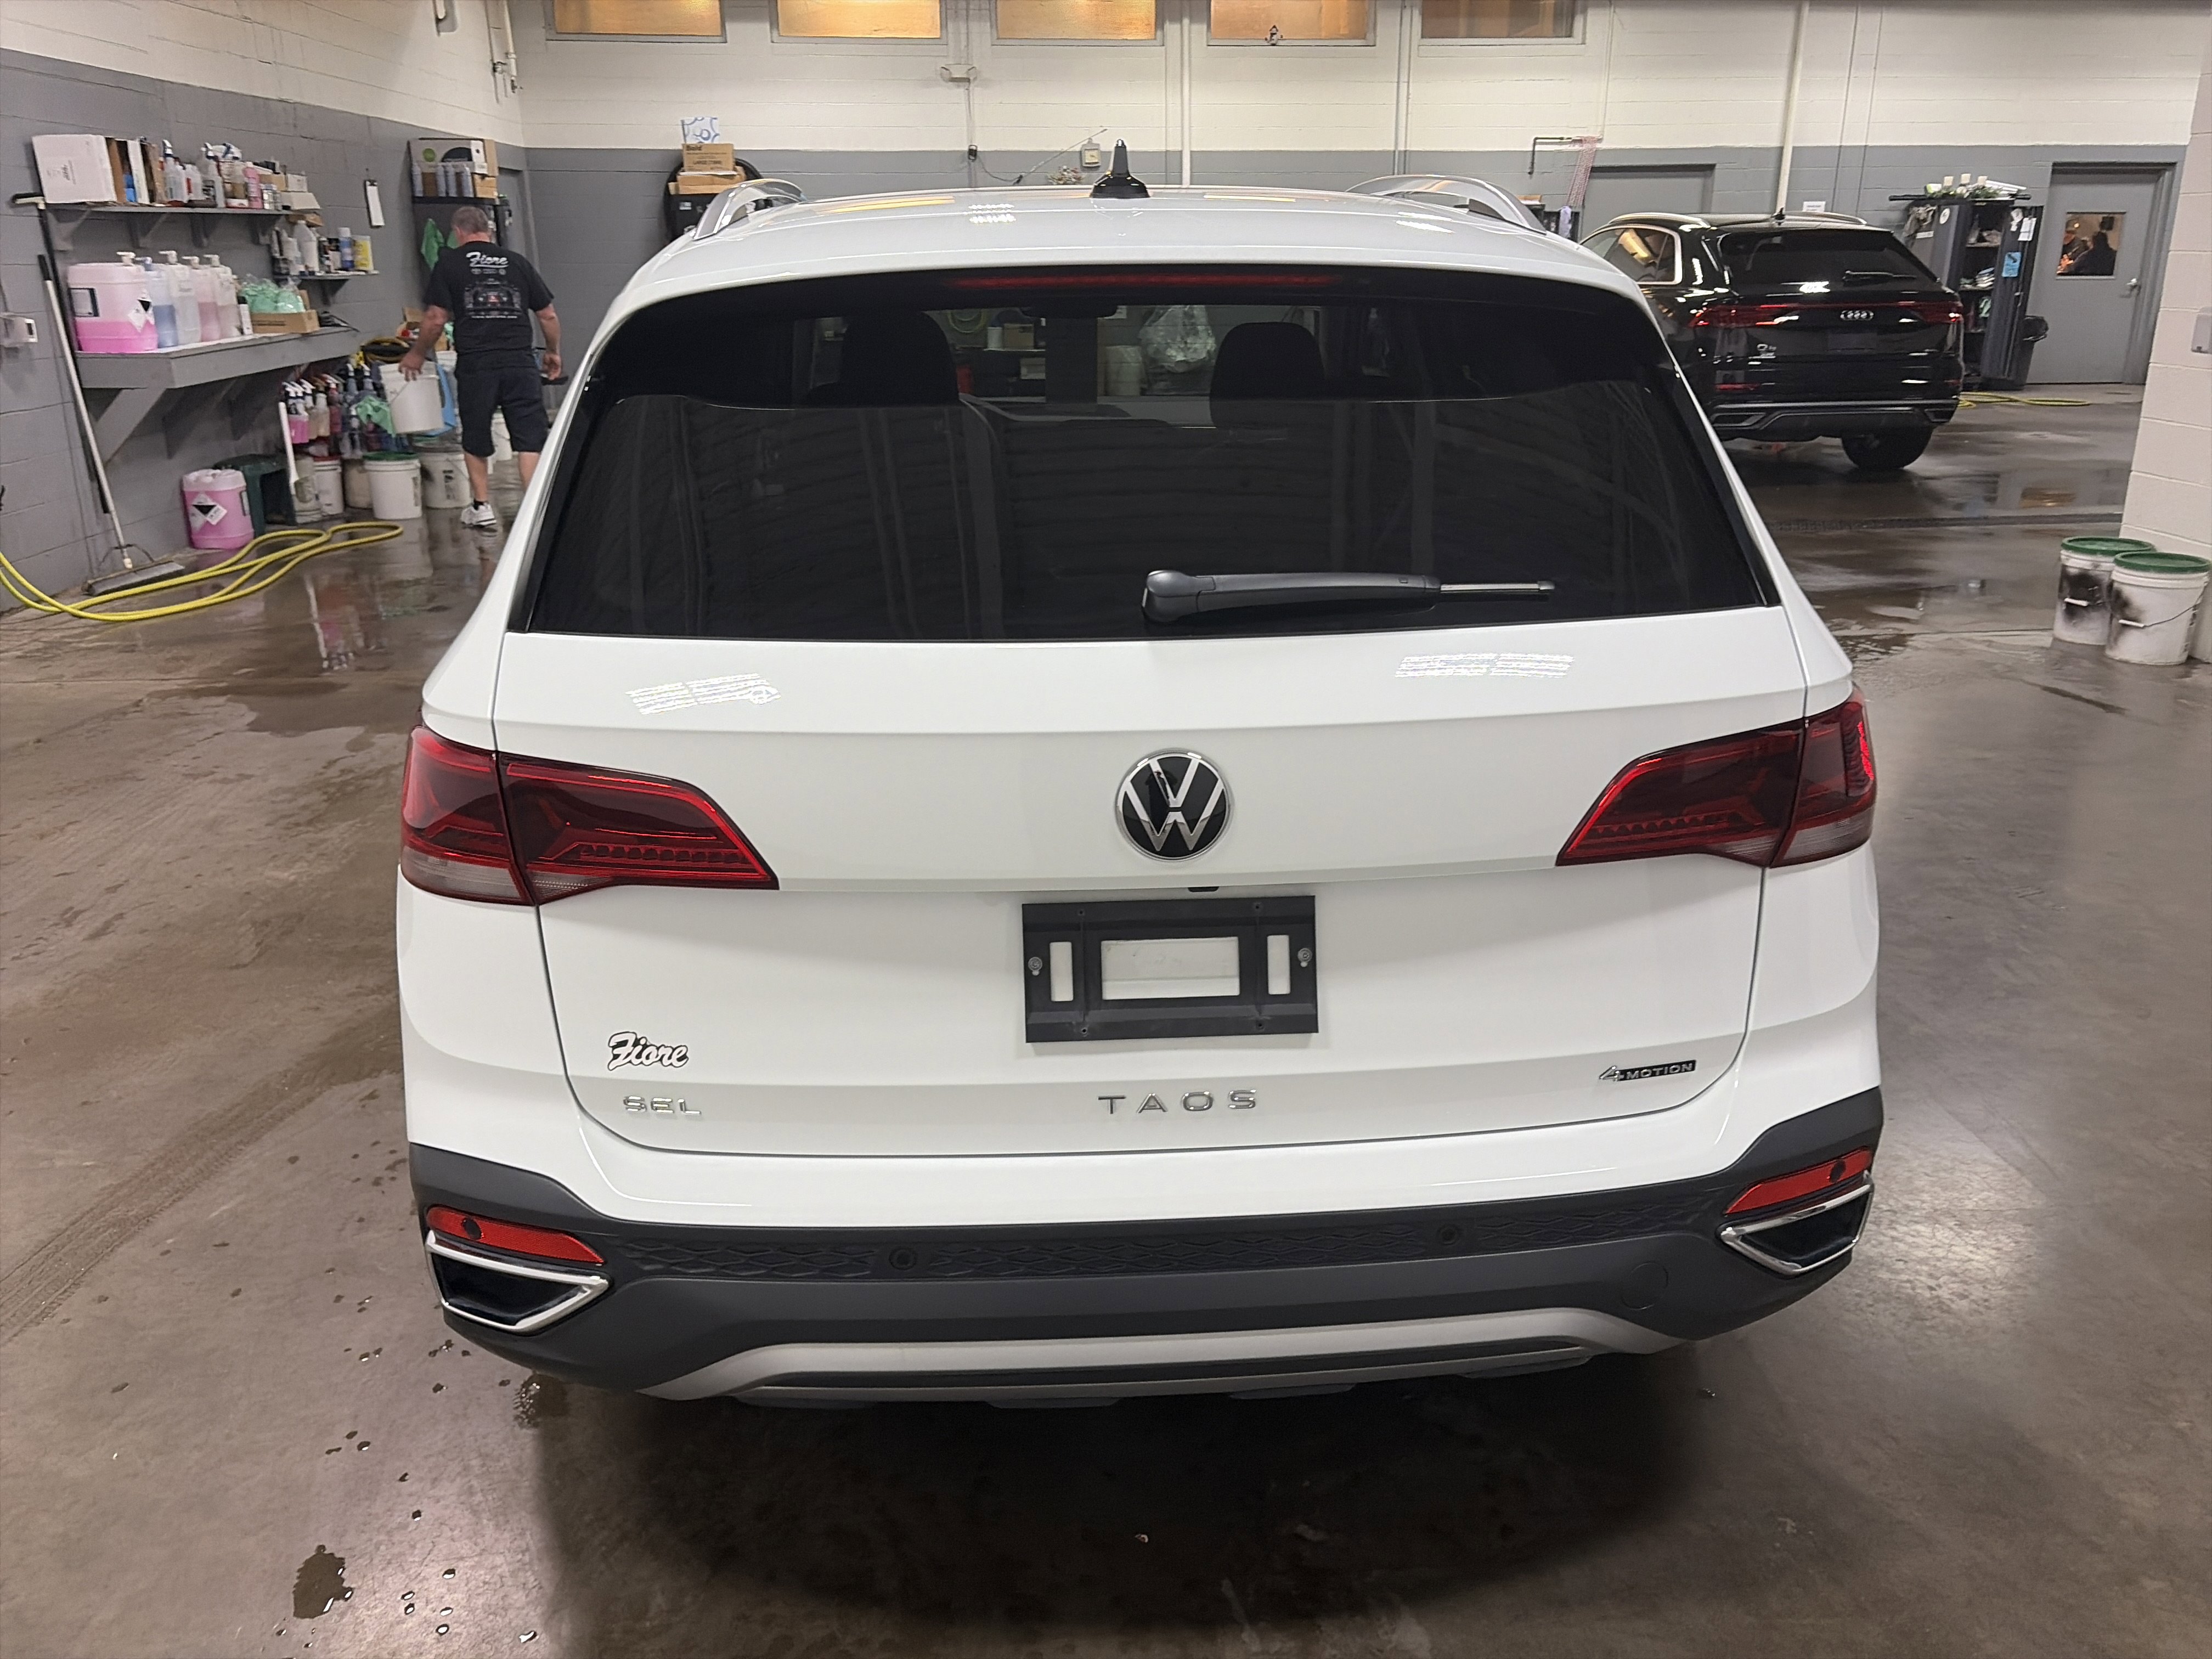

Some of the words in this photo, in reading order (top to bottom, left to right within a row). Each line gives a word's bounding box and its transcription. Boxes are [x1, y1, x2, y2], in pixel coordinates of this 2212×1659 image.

[466, 251, 509, 268] Fiore
[607, 1031, 689, 1071] Fiore
[623, 1096, 702, 1115] SEL
[1098, 1090, 1257, 1114] TAOS
